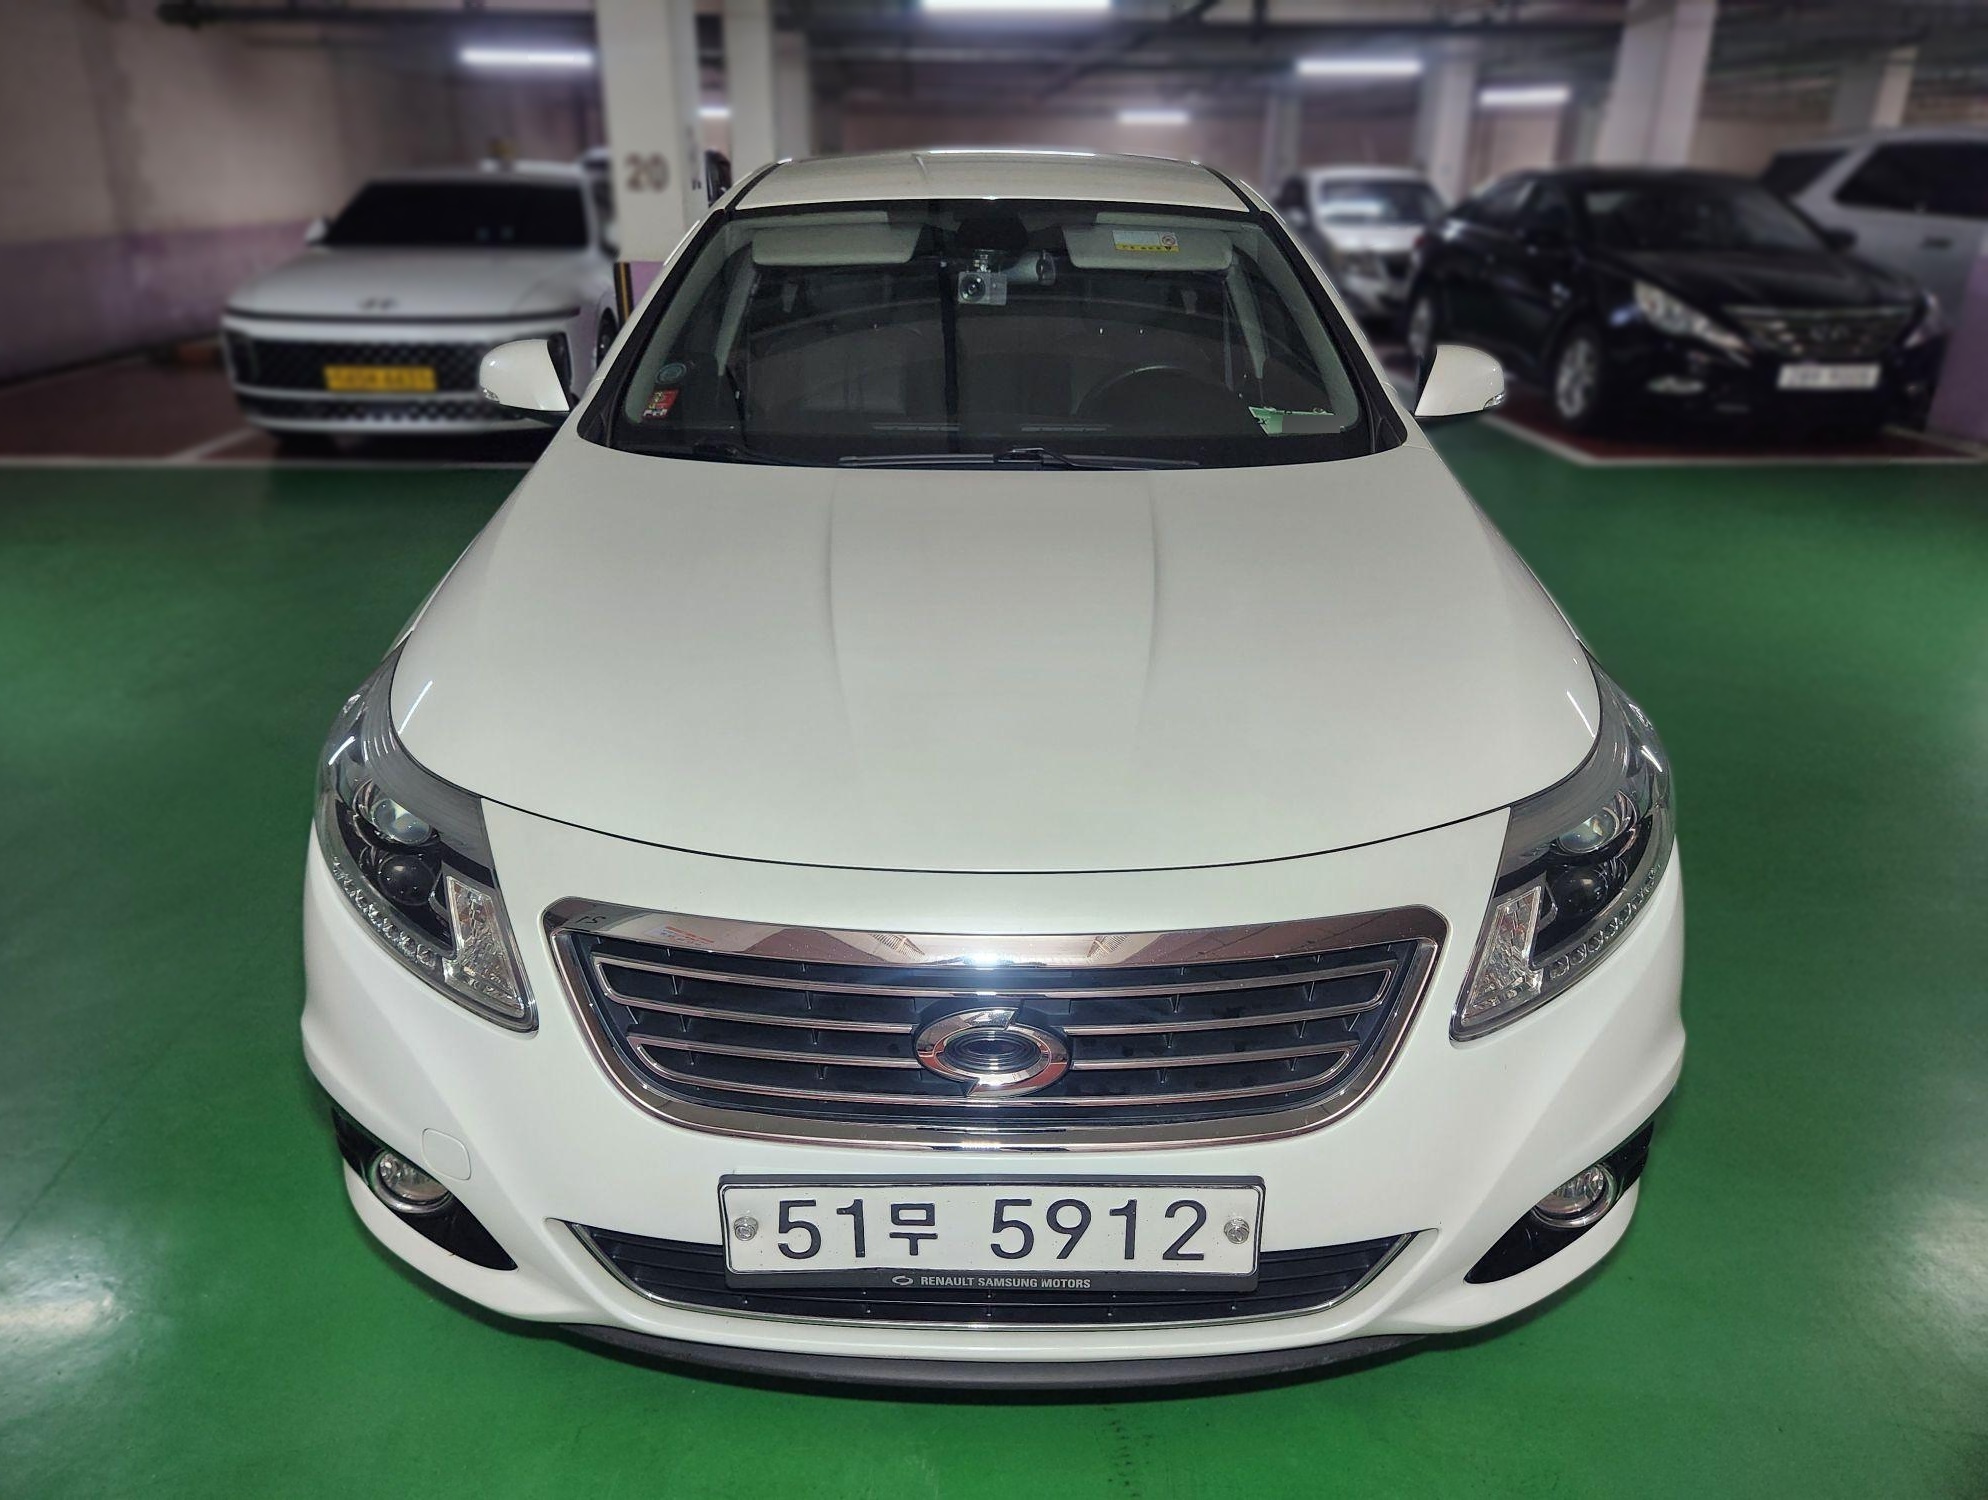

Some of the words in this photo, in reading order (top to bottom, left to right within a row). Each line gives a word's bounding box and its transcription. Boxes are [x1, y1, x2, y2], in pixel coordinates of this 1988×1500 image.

[625, 152, 671, 194] 20
[777, 1198, 939, 1259] 51무
[990, 1198, 1209, 1262] 5912
[920, 1276, 975, 1287] RENAULT
[977, 1277, 1038, 1289] SAMSUNG
[1040, 1278, 1092, 1289] MOTORS
